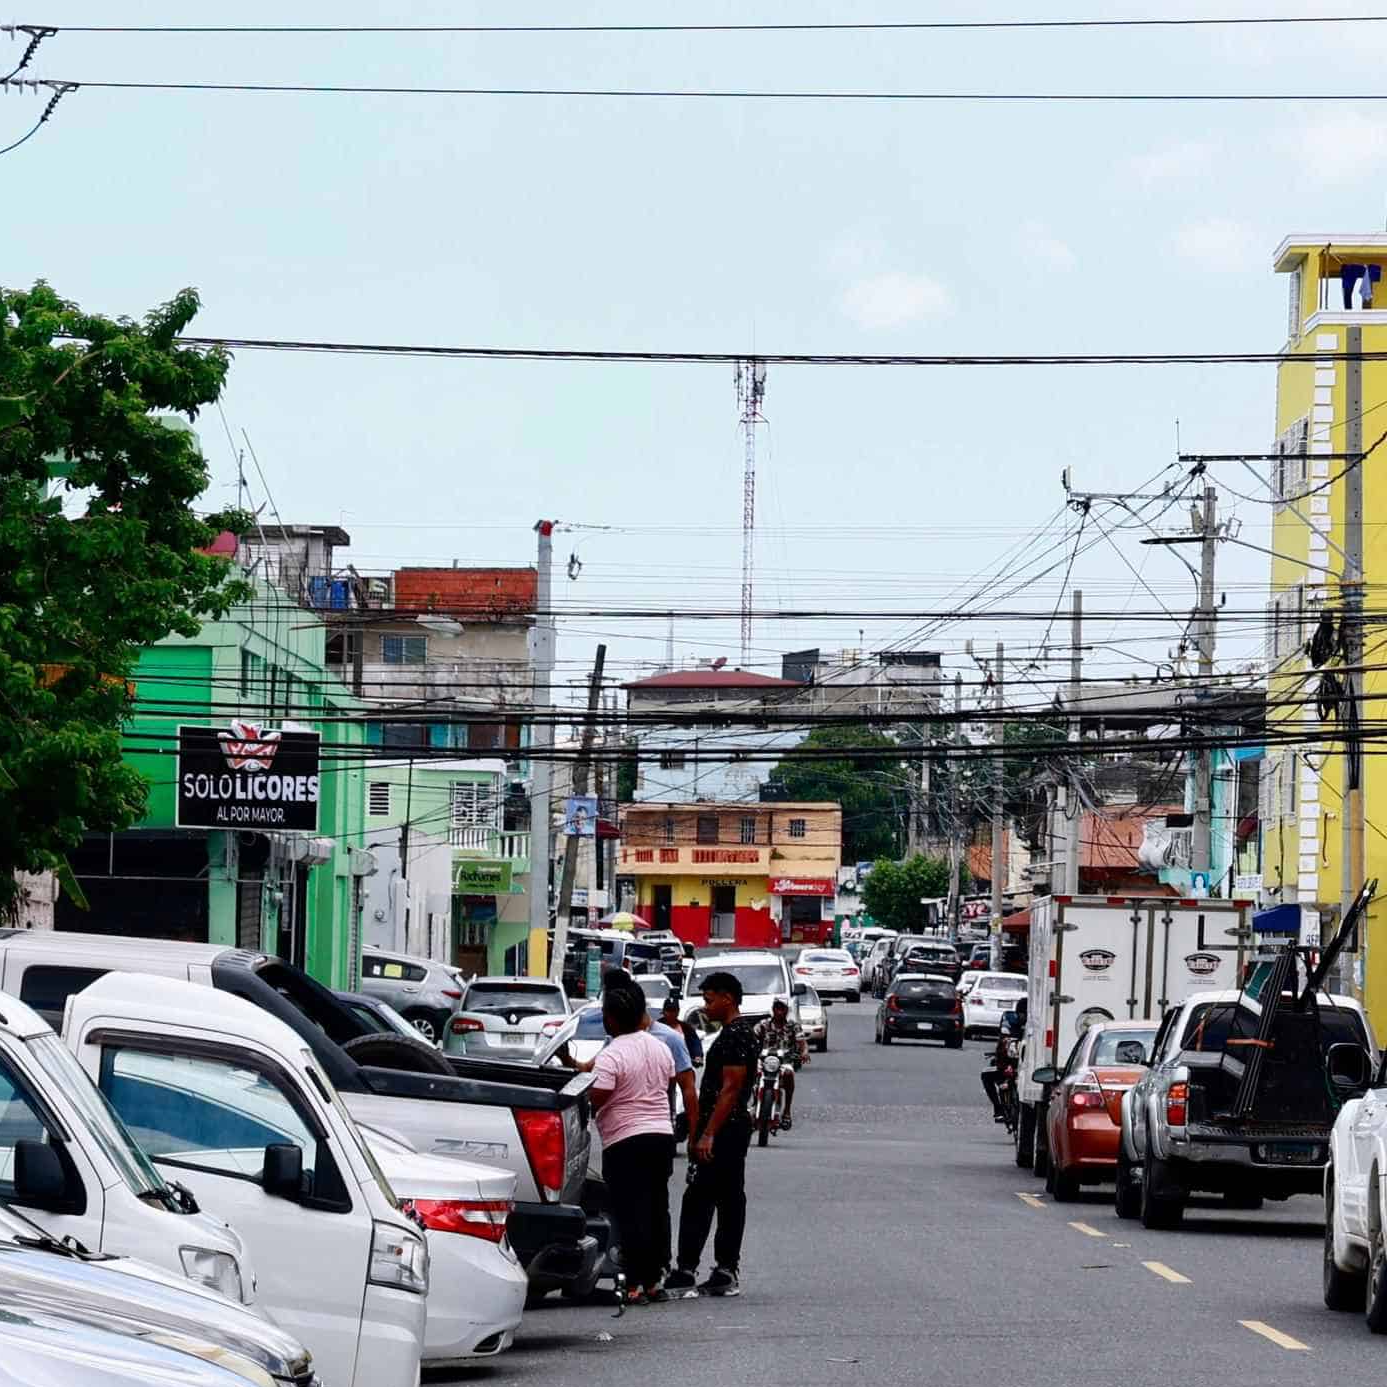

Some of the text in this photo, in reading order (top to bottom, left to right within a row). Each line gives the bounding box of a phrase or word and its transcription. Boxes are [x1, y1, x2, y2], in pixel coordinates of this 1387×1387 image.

[184, 773, 319, 802] SOLO LICORES
[217, 806, 227, 821] AL
[231, 807, 250, 822] POR
